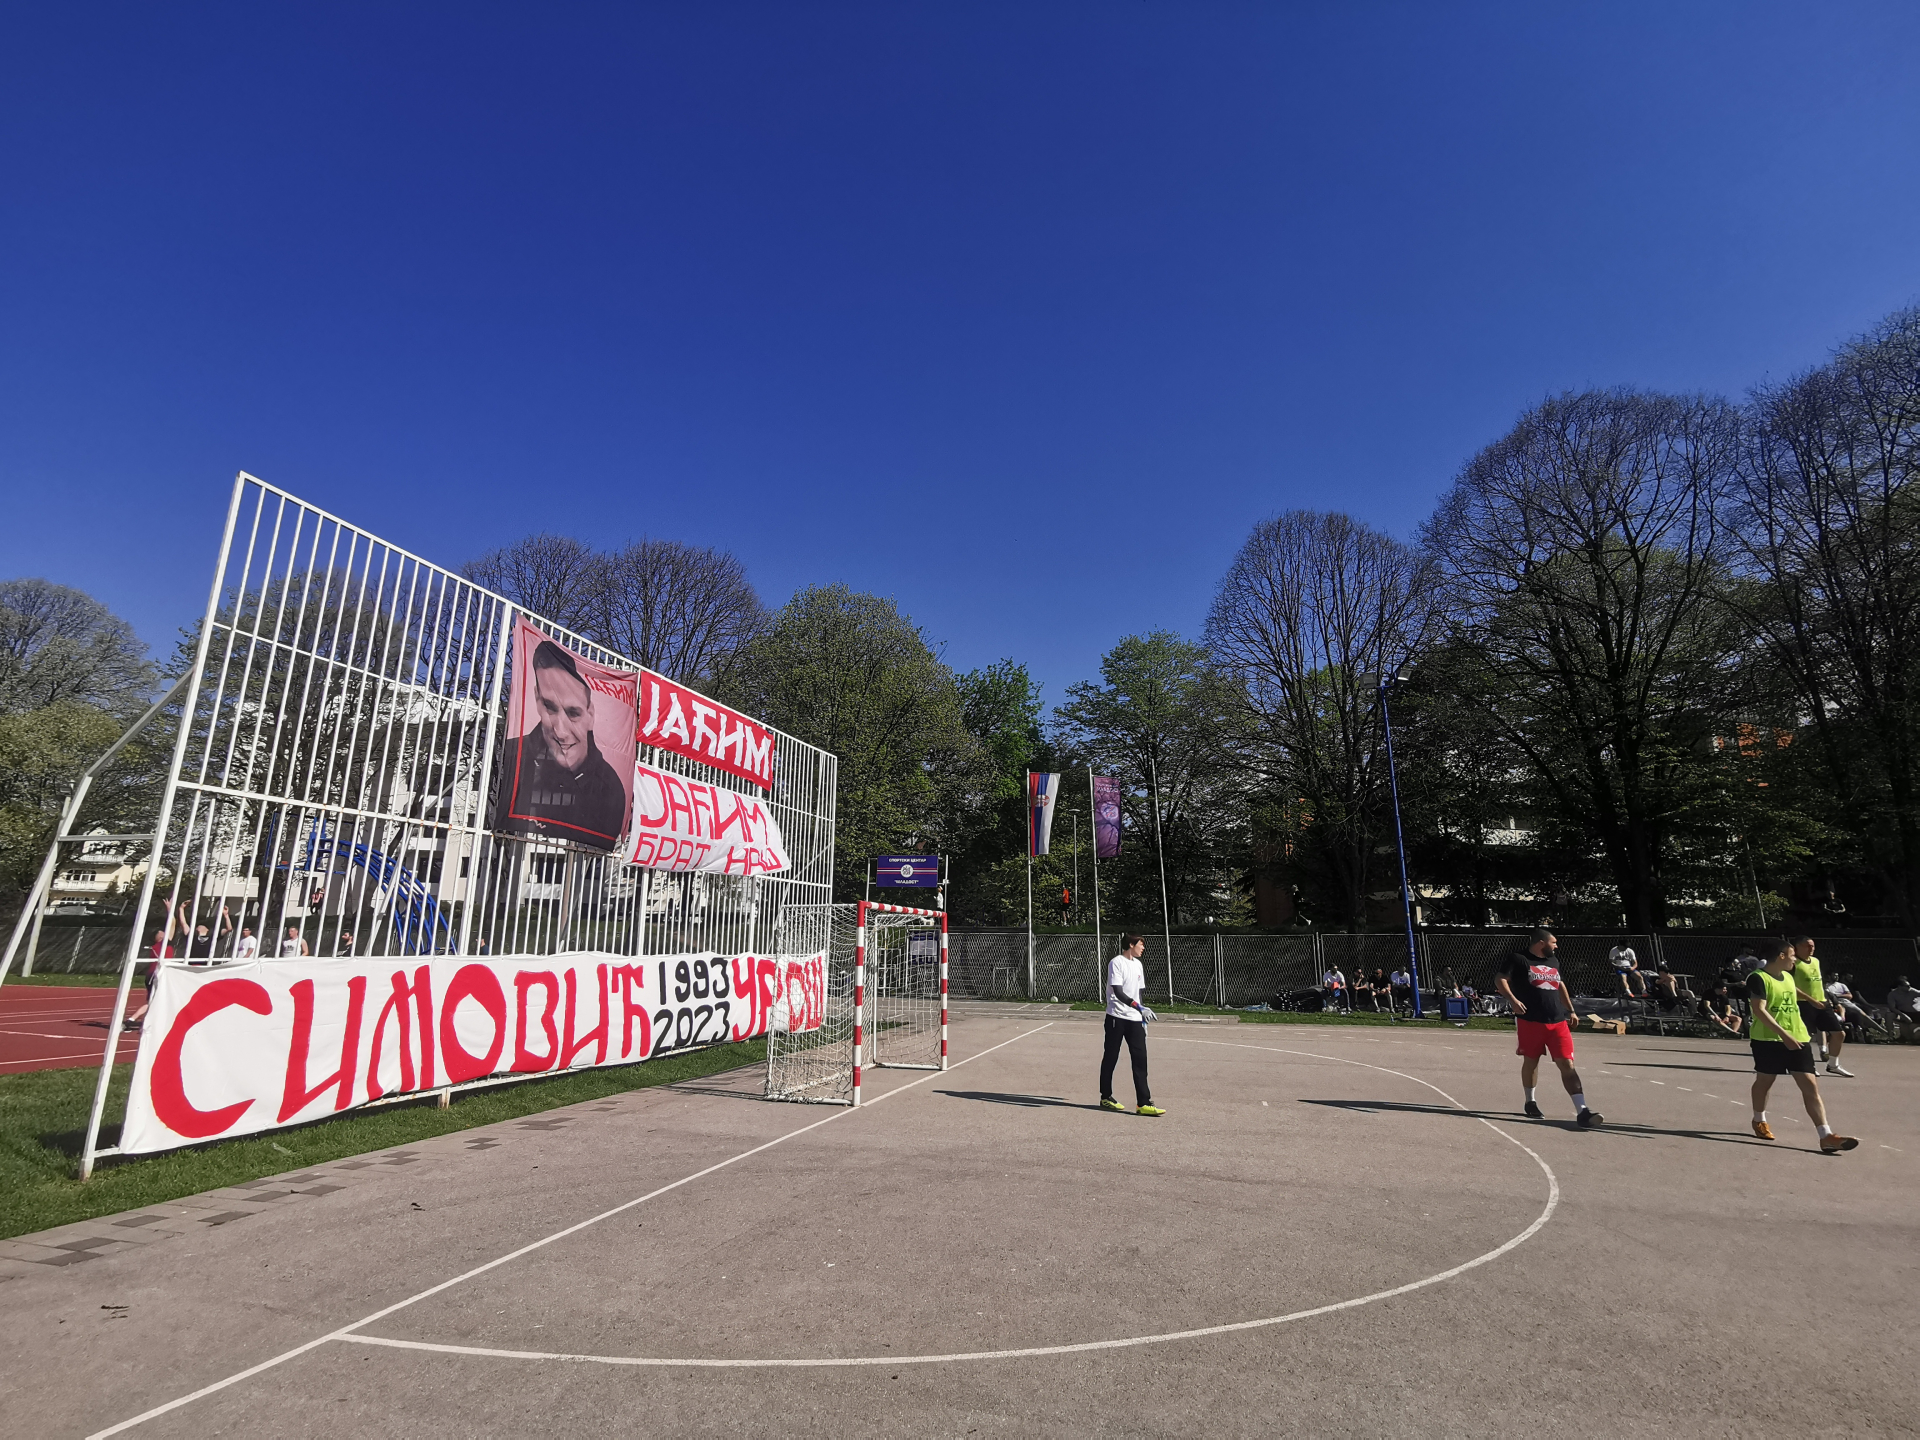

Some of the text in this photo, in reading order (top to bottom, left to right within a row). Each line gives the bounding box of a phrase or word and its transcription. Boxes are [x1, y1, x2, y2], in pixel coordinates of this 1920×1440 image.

[642, 681, 771, 781] ЈАЋИМ
[631, 832, 783, 876] БРАТ НАШ
[658, 957, 730, 1006] 1993
[731, 955, 824, 1043] УРОШ
[150, 963, 651, 1139] СИМОВИЋ
[652, 1001, 731, 1056] 2023
